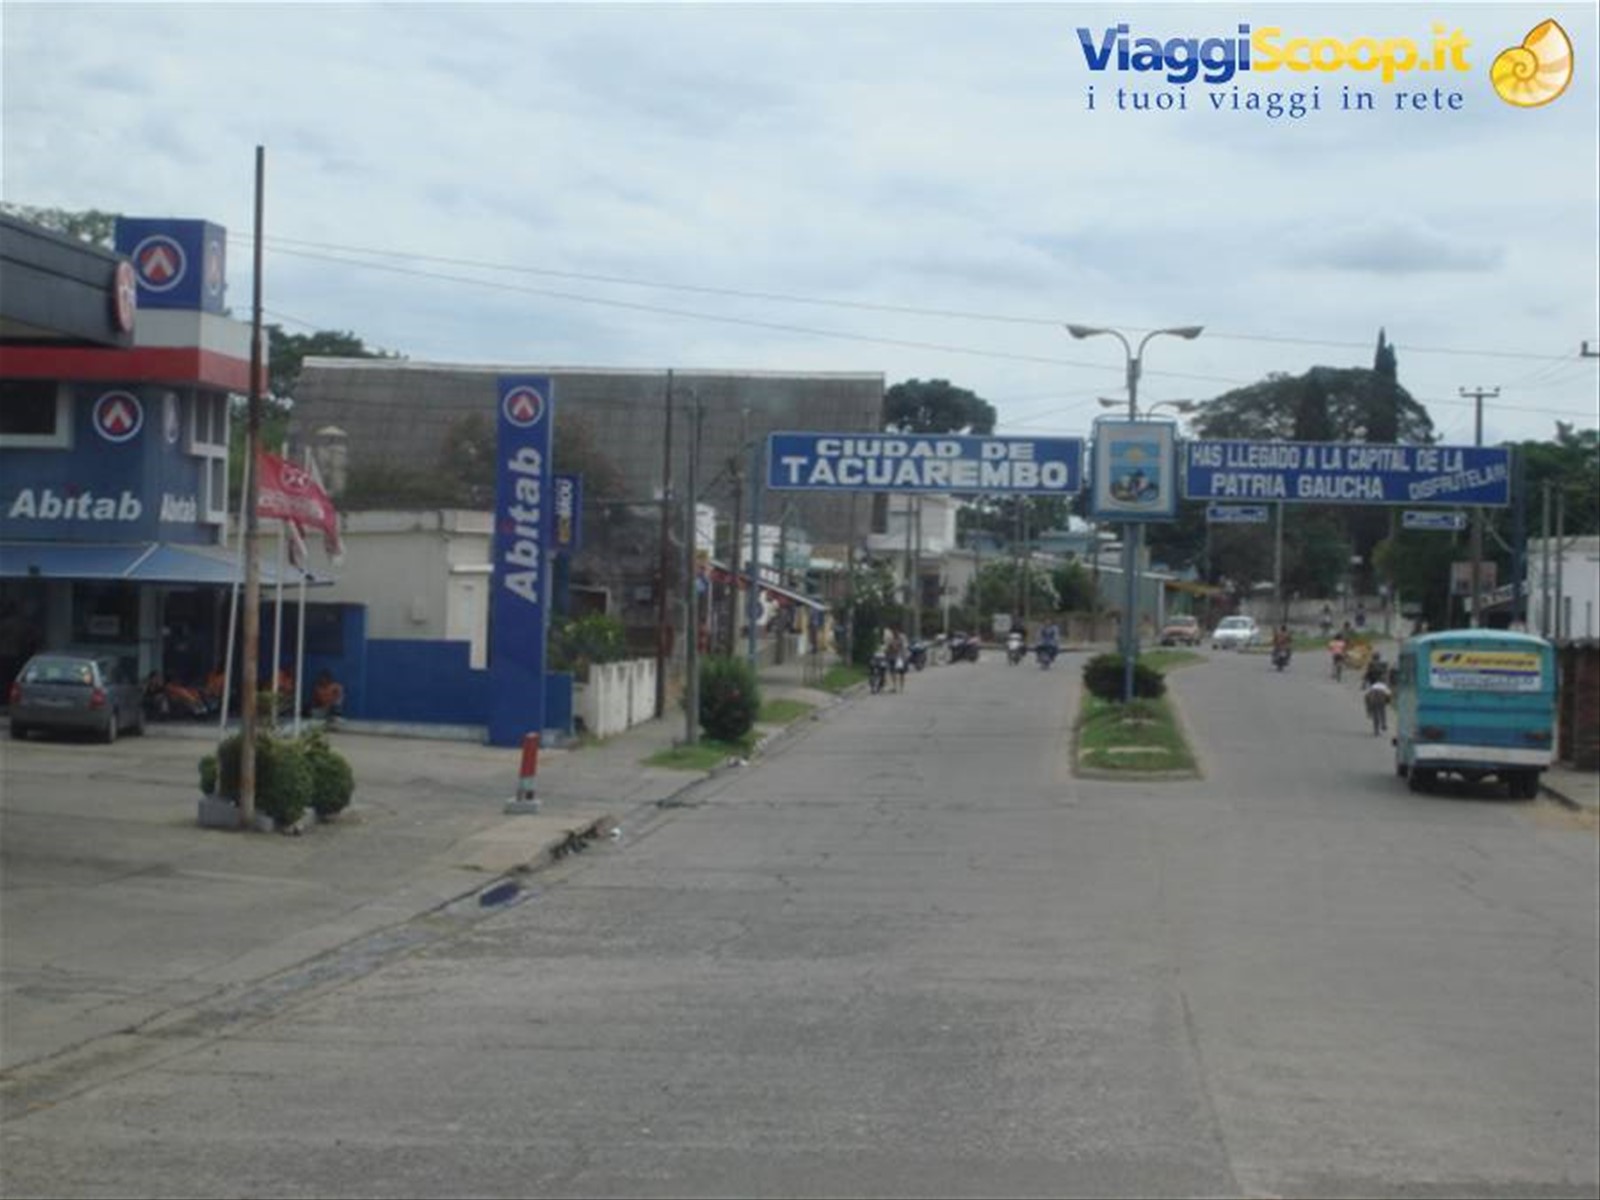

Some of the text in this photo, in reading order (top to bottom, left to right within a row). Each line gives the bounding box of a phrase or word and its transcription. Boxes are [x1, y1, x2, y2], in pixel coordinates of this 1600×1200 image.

[816, 438, 1035, 460] CIUDAD DE
[1192, 444, 1464, 472] HAS LLEGADO A LA CAPITAL DE LA
[781, 456, 1067, 488] TACUAREMBO
[1210, 474, 1384, 500] PATRIA GAUCHA
[8, 485, 143, 521] Abitab
[504, 447, 543, 604] Abitab
